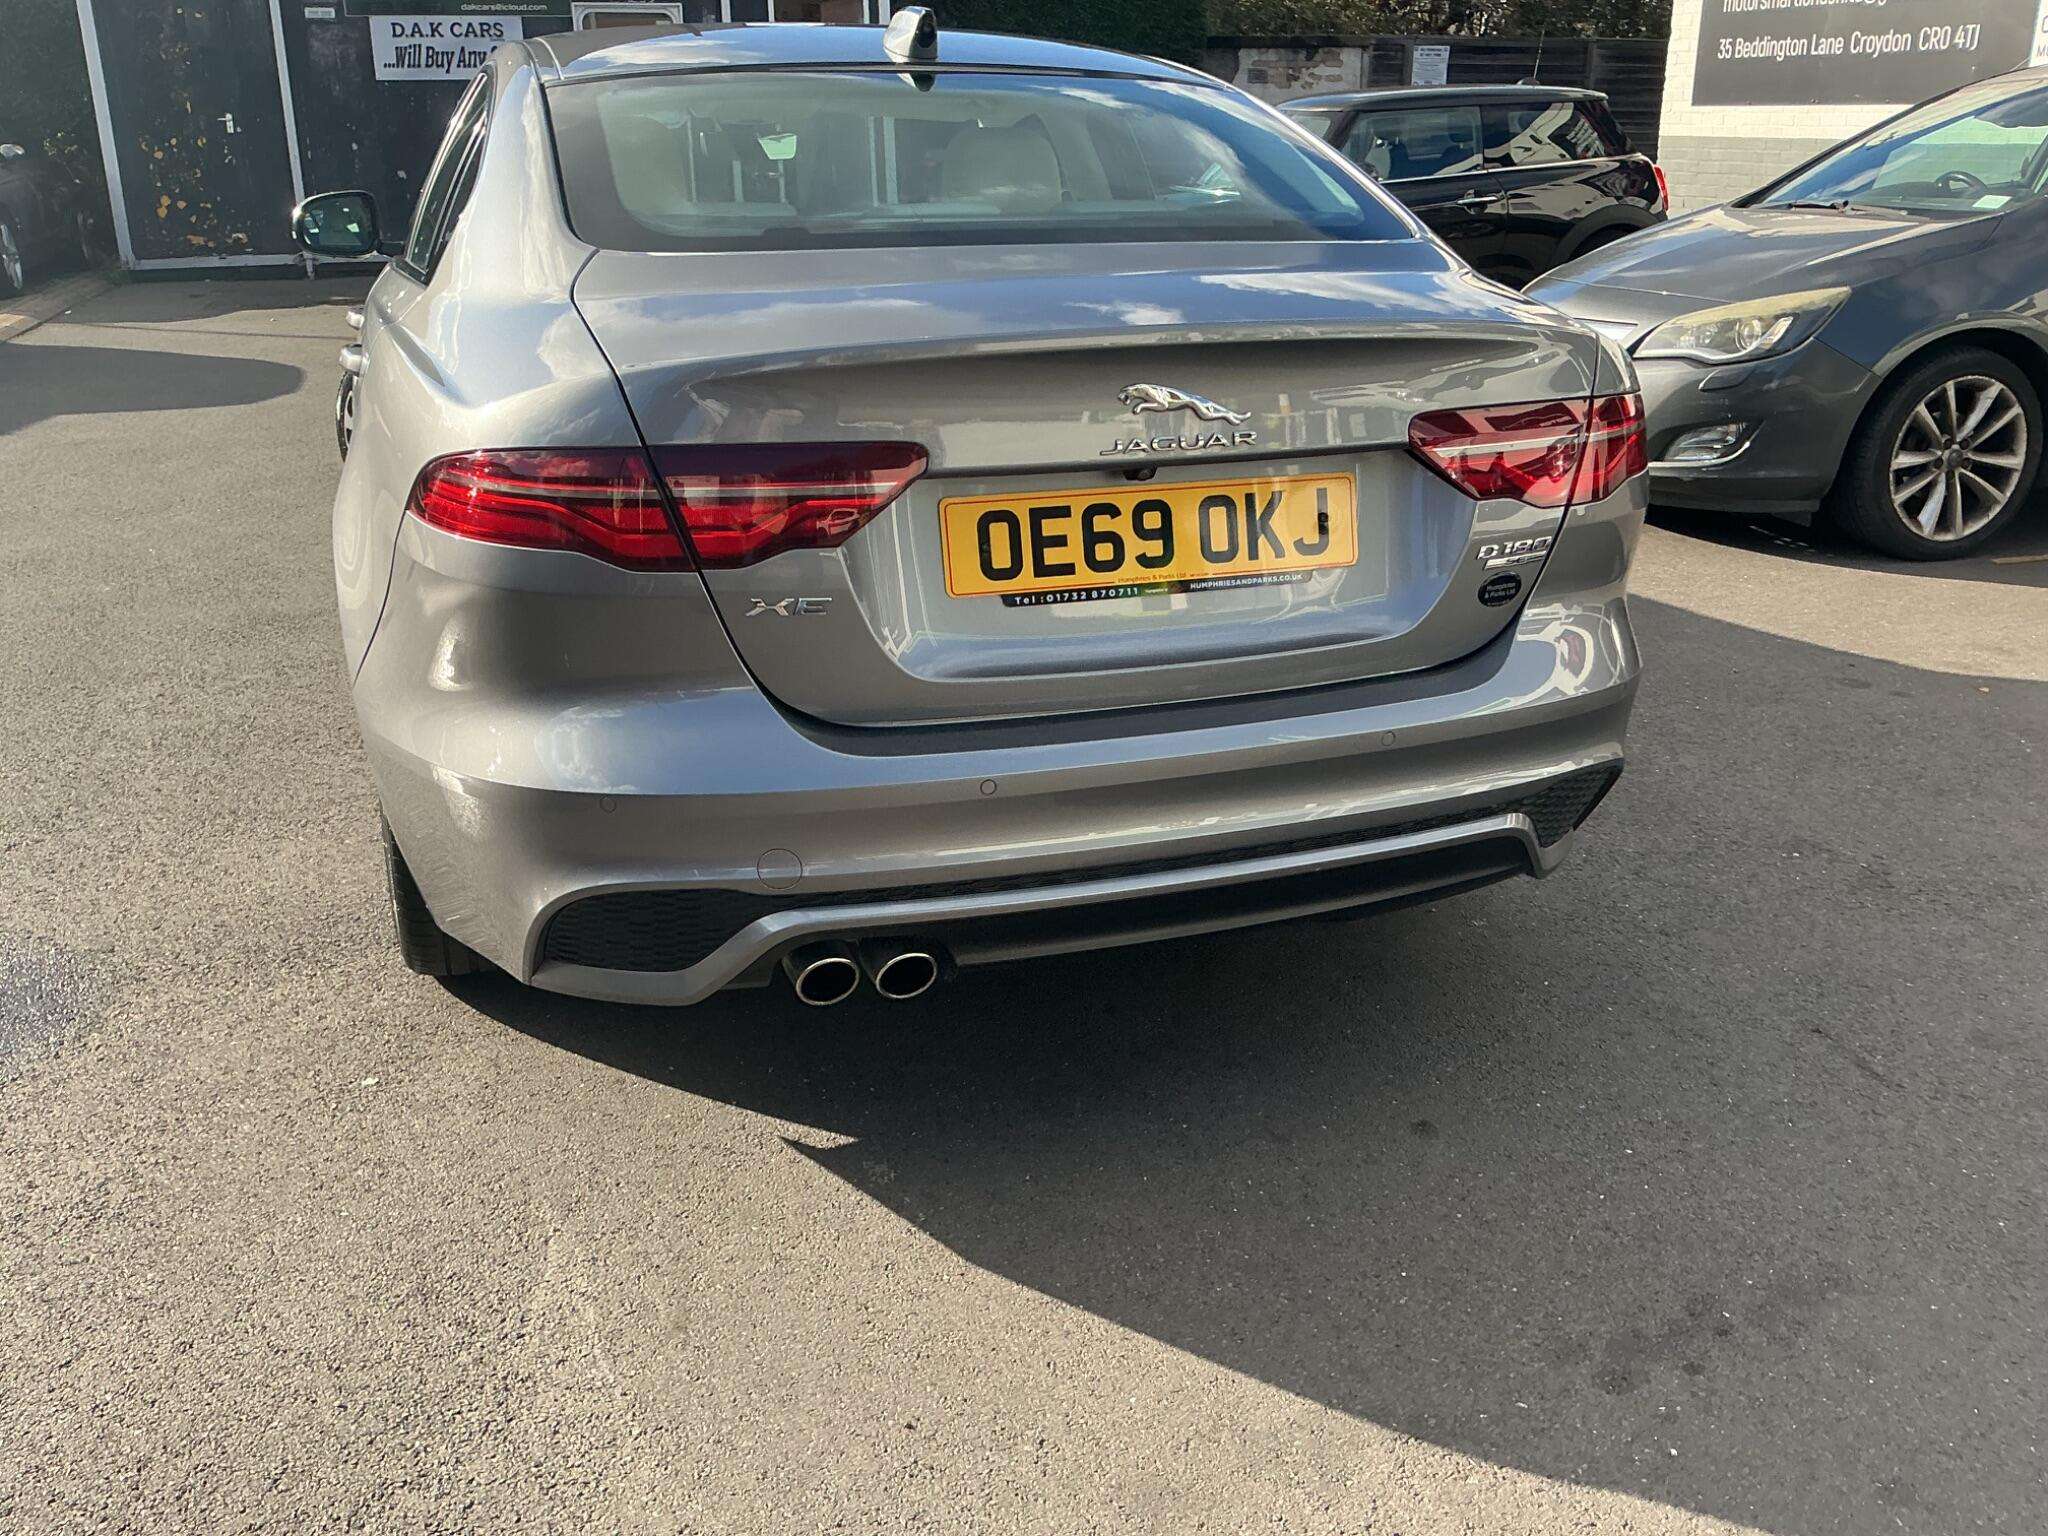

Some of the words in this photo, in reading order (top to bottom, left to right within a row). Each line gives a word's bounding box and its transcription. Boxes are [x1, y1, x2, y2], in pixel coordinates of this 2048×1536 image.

[391, 22, 444, 38] D.A.K
[450, 22, 504, 38] CARS
[1717, 38, 1732, 59] 35
[1735, 35, 1807, 61] Beddington
[1811, 36, 1844, 56] Lane
[1850, 31, 1912, 60] Croydon
[1954, 23, 1981, 50] 4TJ
[425, 46, 455, 73] Buy
[1100, 430, 1258, 456] JAGUAR
[976, 498, 1175, 583] OE69
[1198, 487, 1331, 565] OKJ
[1476, 536, 1552, 559] D180
[1091, 586, 1139, 599] 870711
[1189, 573, 1304, 590] HUMPHRIESANDPARKS.CO.UK
[745, 597, 833, 616] XE
